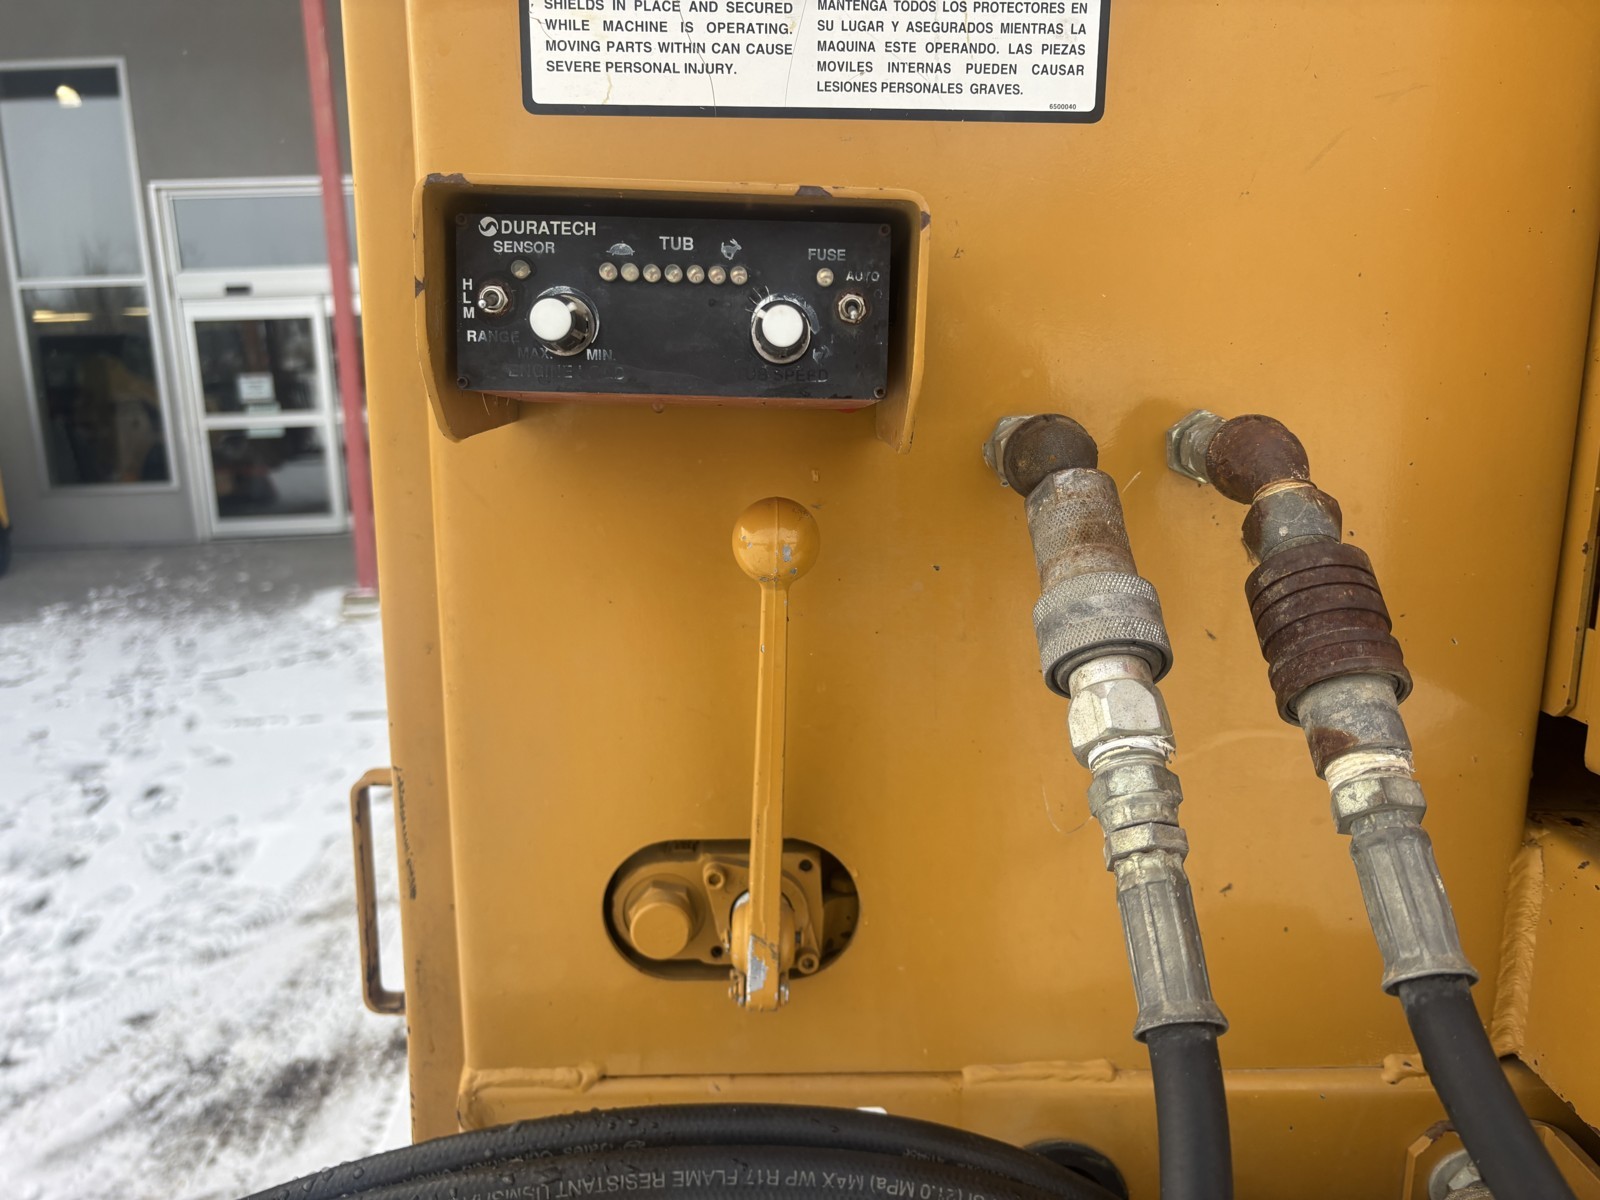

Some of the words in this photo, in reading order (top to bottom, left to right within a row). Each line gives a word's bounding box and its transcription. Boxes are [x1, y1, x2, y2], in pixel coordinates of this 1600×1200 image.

[544, 0, 605, 10] SHIELDS
[612, 0, 626, 11] IN
[634, 0, 681, 12] PLACE
[689, 0, 718, 13] AND
[726, 1, 793, 14] SECURED
[817, 0, 888, 11] MANTENGA
[893, 0, 937, 12] TODOS
[942, 0, 968, 13] LOS
[973, 1, 1066, 14] PROTECTORES
[1071, 2, 1088, 14] EN
[544, 18, 590, 31] WHILE
[603, 20, 668, 32] MACHINE
[680, 21, 694, 33] IS
[706, 21, 793, 35] OPERATING.
[817, 19, 834, 31] SU
[841, 20, 884, 32] LUGAR
[891, 20, 899, 32] Y
[905, 21, 994, 34] ASEGURADOS
[1000, 22, 1064, 35] MIENTRAS
[1070, 23, 1087, 35] LA
[545, 39, 601, 52] MOVING
[606, 40, 653, 53] PARTS
[657, 41, 706, 54] WITHIN
[711, 42, 740, 54] CAN
[746, 43, 793, 55] CAUSE
[817, 40, 876, 52] MAQUINA
[884, 41, 917, 53] ESTE
[925, 42, 1000, 55] OPERANDO.
[1008, 43, 1033, 55] LAS
[1041, 43, 1086, 55] PIEZAS
[546, 60, 601, 73] SEVERE
[605, 61, 680, 74] PERSONAL
[684, 62, 737, 75] INJURY.
[817, 60, 874, 73] MOVILES
[887, 61, 952, 74] INTERNAS
[965, 63, 1017, 75] PUEDEN
[1031, 64, 1085, 76] CAUSAR
[816, 81, 878, 93] LESIONES
[880, 82, 964, 95] PERSONALES
[969, 83, 1024, 96] GRAVES.
[501, 219, 597, 236] DURATECH
[493, 240, 555, 254] SENSOR
[658, 235, 694, 251] TUB
[808, 248, 846, 261] FUSE
[462, 278, 473, 290] H
[462, 290, 472, 304] L
[463, 307, 475, 319] M
[467, 330, 520, 343] RANGE
[586, 348, 617, 361] MIN.
[672, 1168, 739, 1187] FLAME
[745, 1168, 780, 1186] R17
[784, 1169, 816, 1188] WP
[555, 1171, 666, 1199] RESISTANT
[869, 1173, 916, 1199] MPa)
